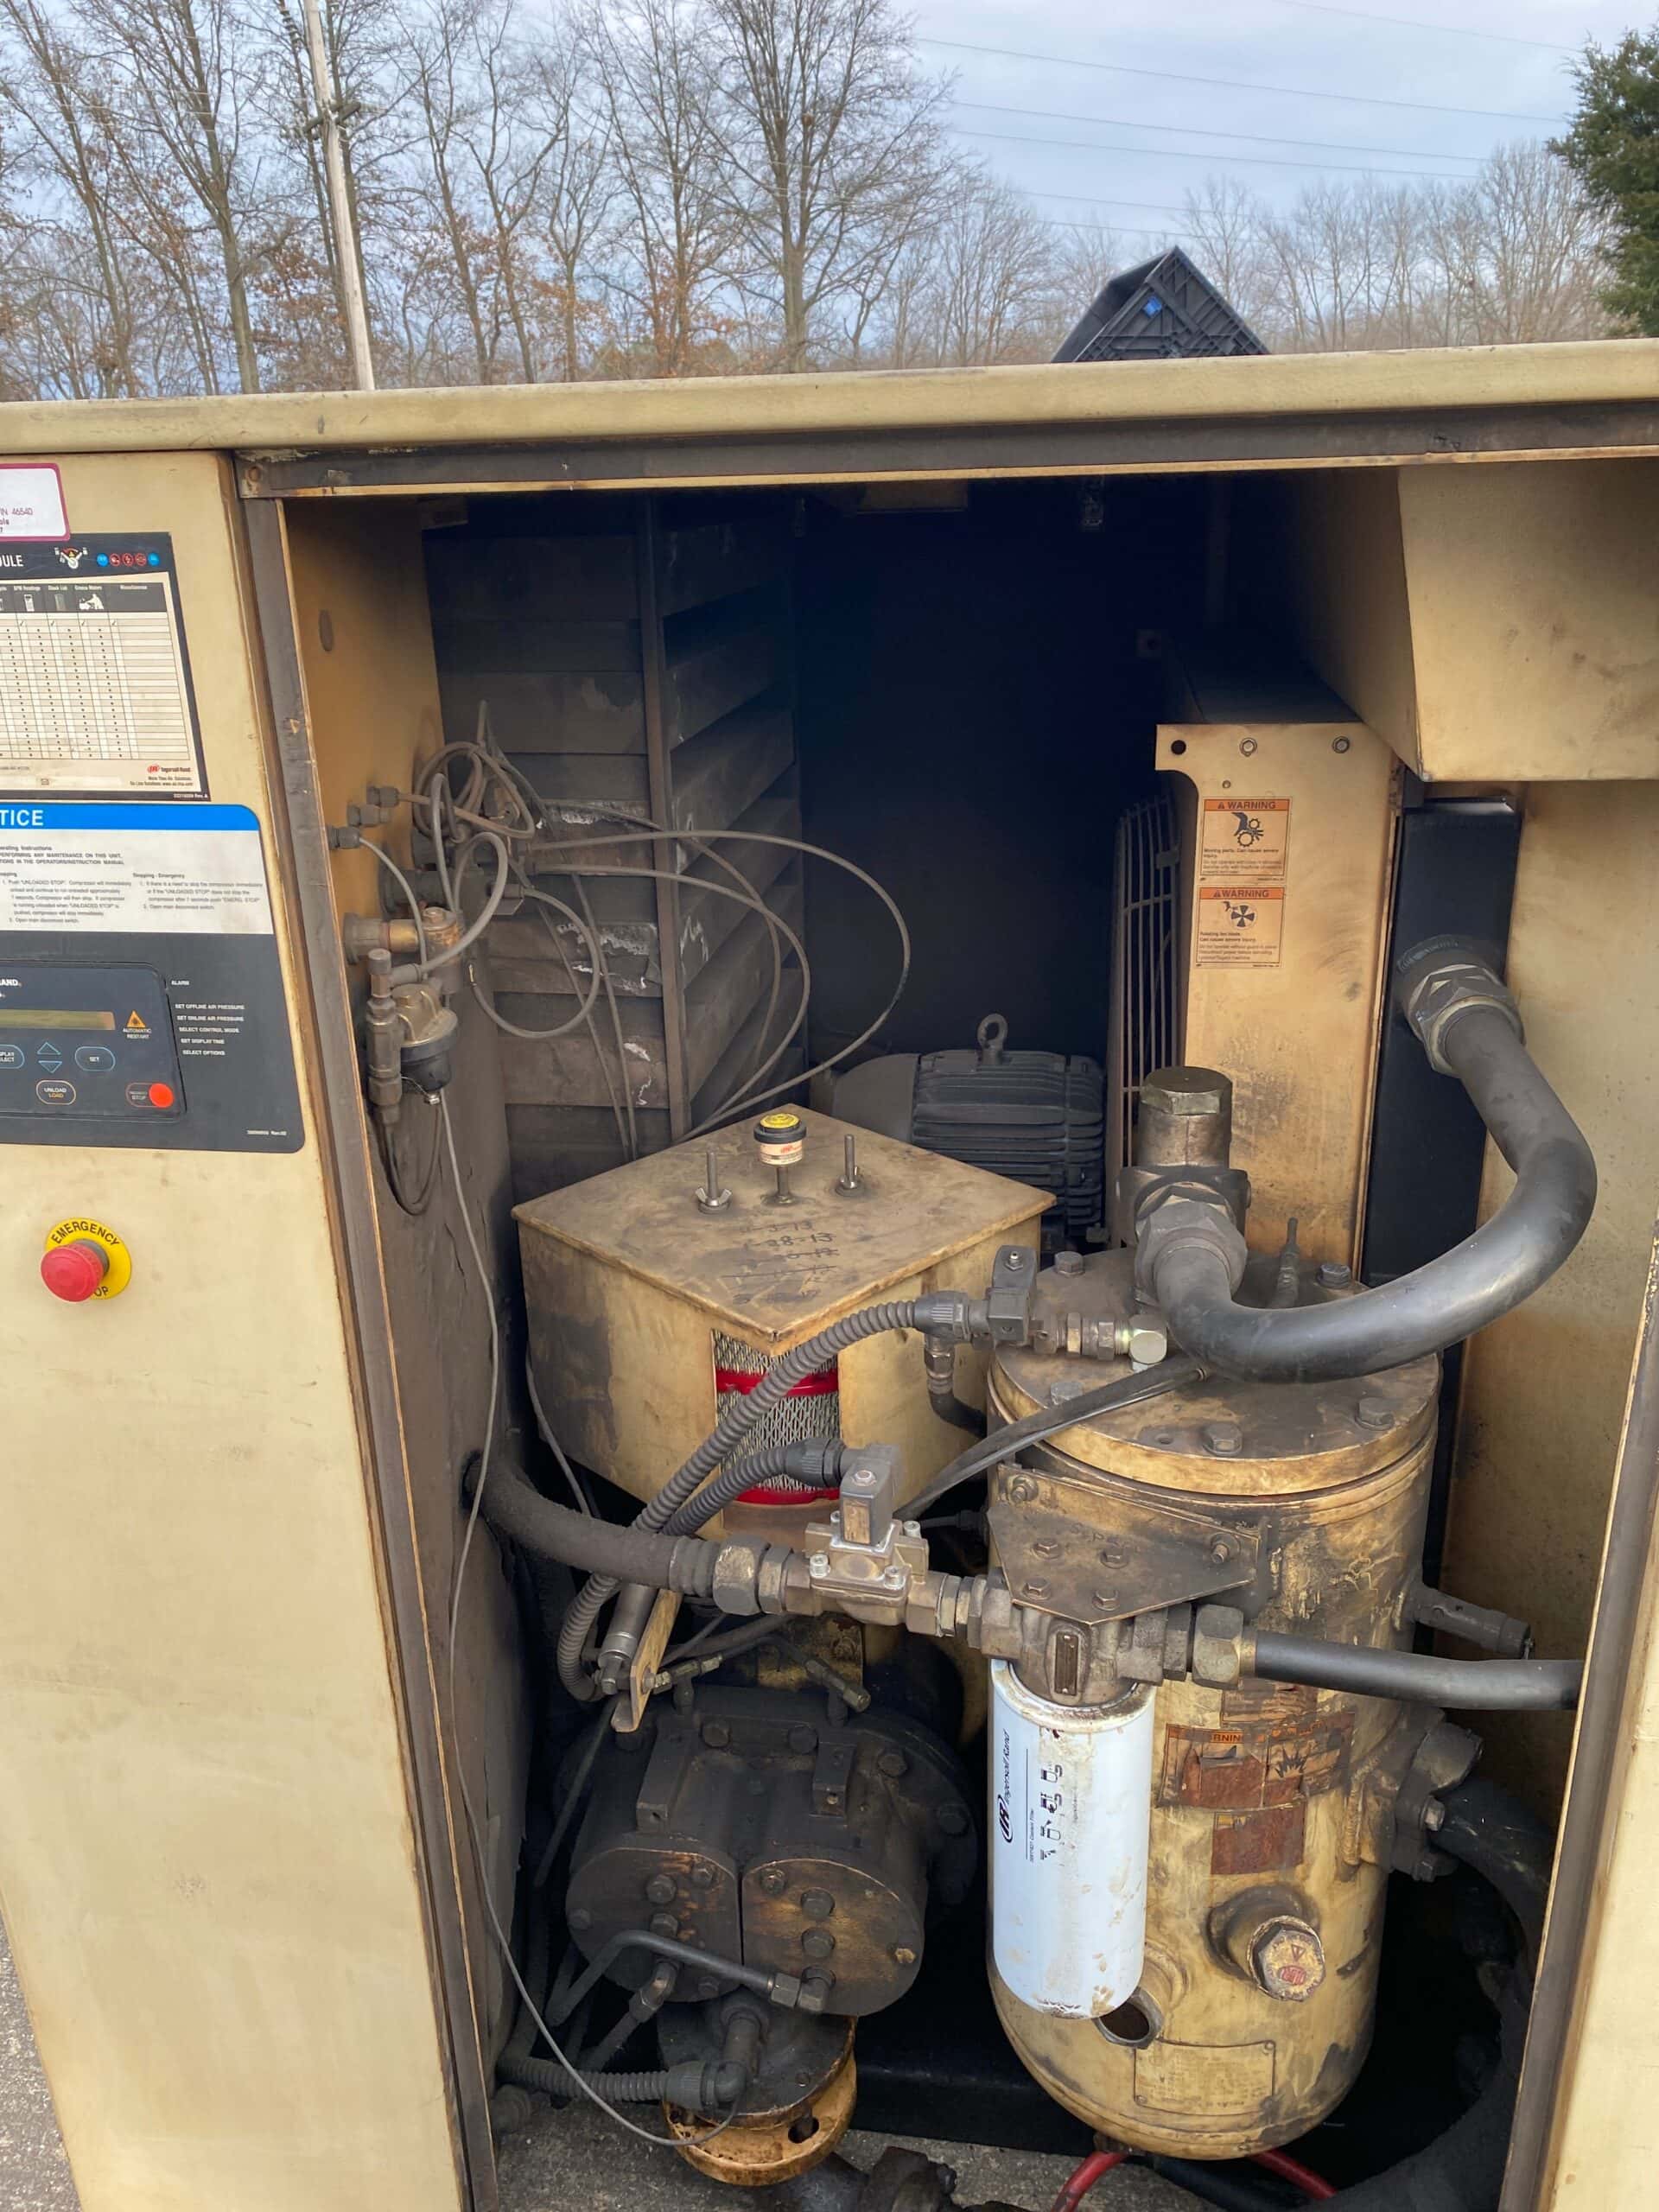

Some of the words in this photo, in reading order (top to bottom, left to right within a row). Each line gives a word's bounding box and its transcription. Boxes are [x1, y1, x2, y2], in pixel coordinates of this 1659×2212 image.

[1227, 801, 1276, 810] WARNING
[1221, 889, 1270, 898] WARNING
[50, 1220, 120, 1246] EMERGENCY
